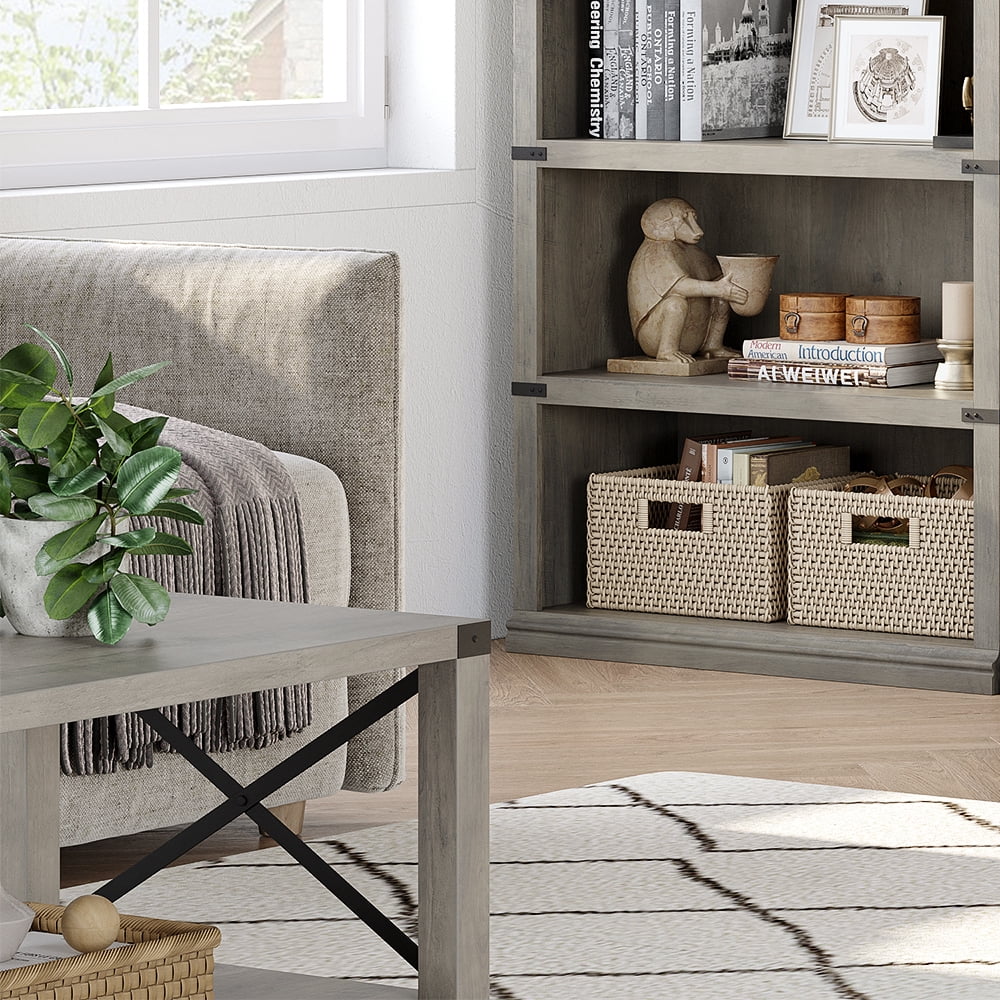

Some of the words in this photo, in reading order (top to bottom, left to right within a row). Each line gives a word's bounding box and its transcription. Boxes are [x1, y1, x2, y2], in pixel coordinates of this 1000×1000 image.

[666, 10, 676, 56] Forming
[685, 11, 696, 55] Forming
[605, 46, 618, 91] ENGLAND
[619, 45, 633, 92] ENGLAND
[667, 57, 675, 65] a
[686, 57, 694, 65] a
[589, 57, 603, 138] Chemistry
[667, 66, 676, 102] Nation
[686, 67, 696, 102] Nation
[747, 350, 788, 360] American
[750, 340, 782, 350] Modern
[798, 344, 883, 363] Introduction
